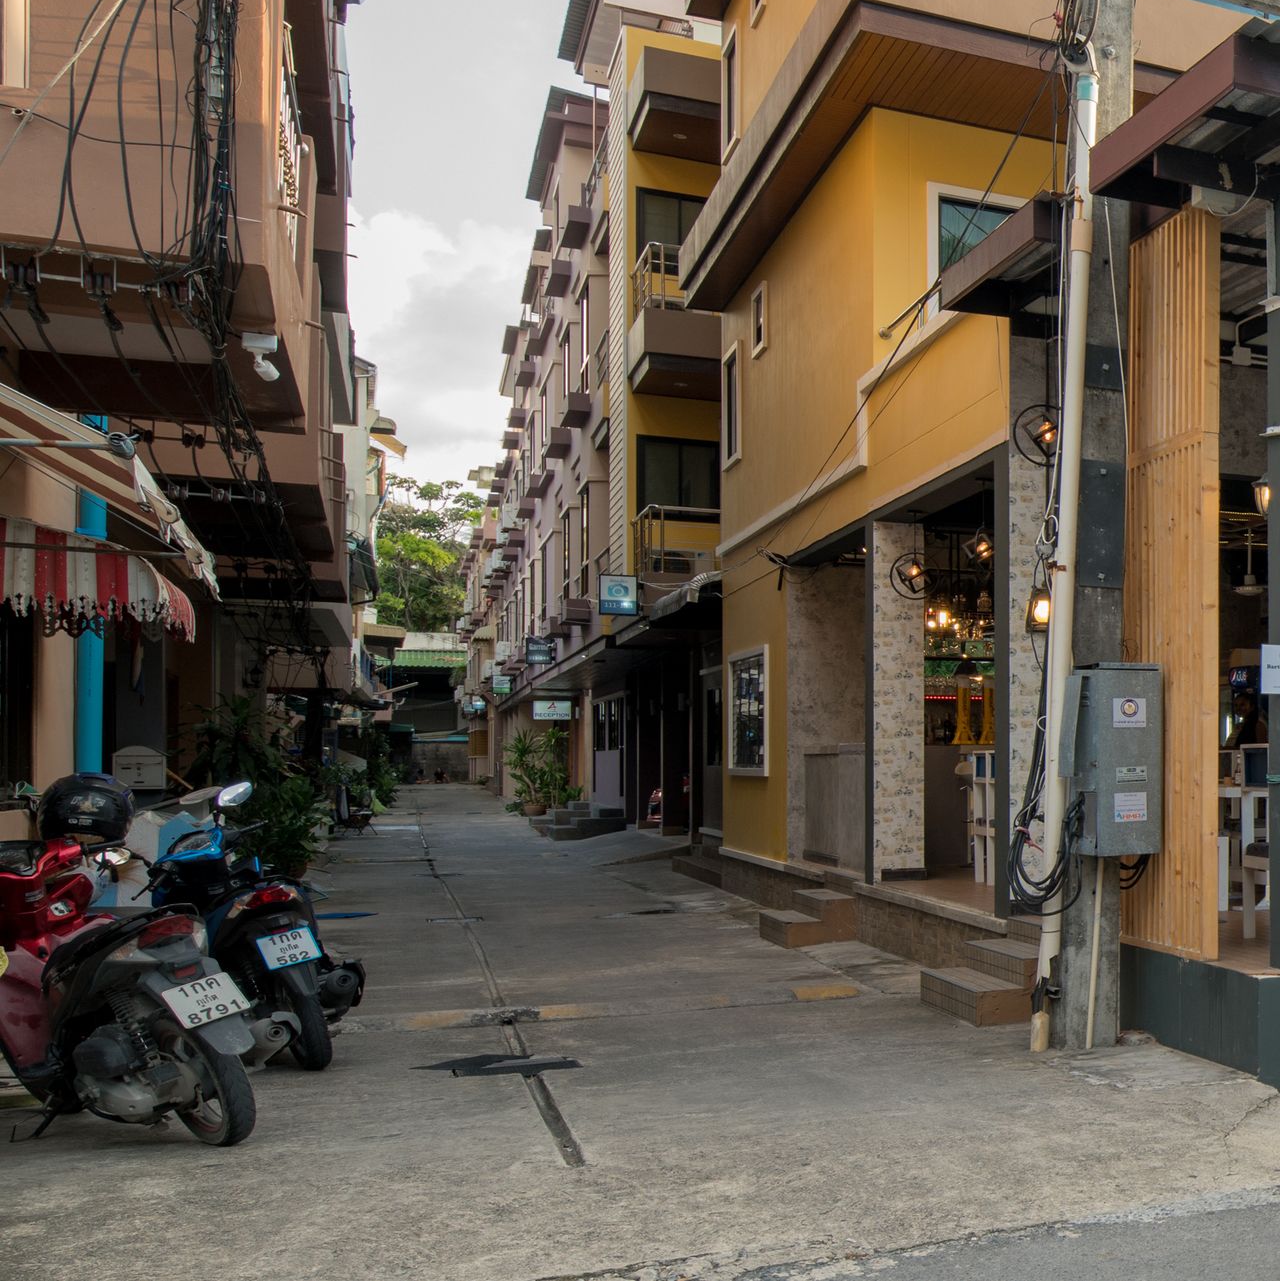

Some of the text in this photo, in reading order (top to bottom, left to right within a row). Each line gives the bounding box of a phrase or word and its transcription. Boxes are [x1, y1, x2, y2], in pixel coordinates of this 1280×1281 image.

[276, 950, 311, 965] 582
[178, 977, 222, 998] 1กค
[196, 994, 219, 1008] ภูเก็ต
[187, 998, 242, 1025] 8791
